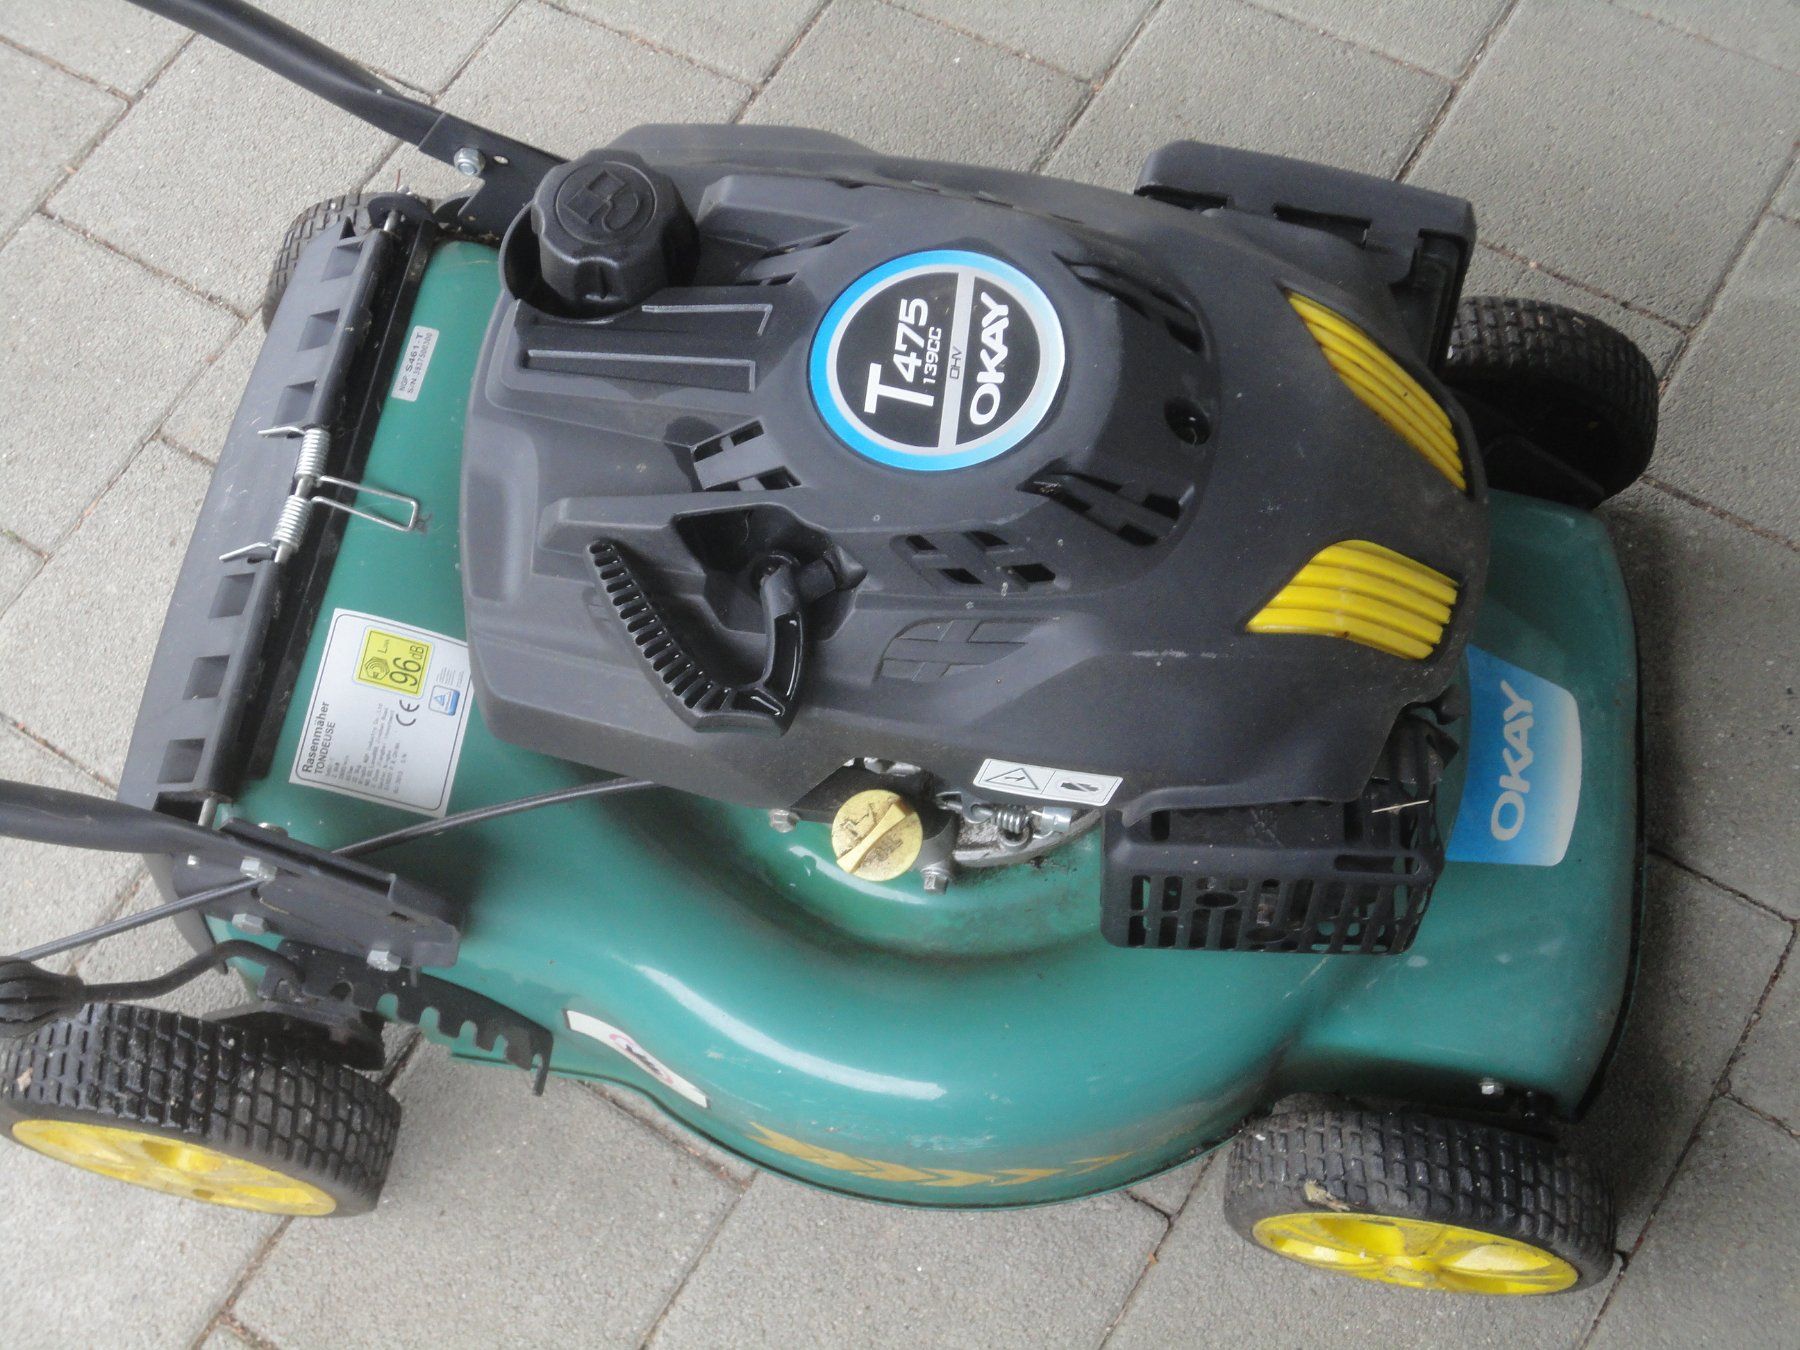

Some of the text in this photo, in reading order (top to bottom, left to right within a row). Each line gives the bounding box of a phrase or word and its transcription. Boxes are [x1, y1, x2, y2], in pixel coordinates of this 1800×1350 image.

[923, 326, 942, 384] 139CC
[949, 345, 963, 380] OHV
[969, 291, 1010, 426] OKAY
[388, 644, 425, 687] 96 dB
[301, 701, 330, 773] Rasenmäher
[314, 721, 336, 775] TONDEUSE
[1490, 679, 1534, 842] OKAY
